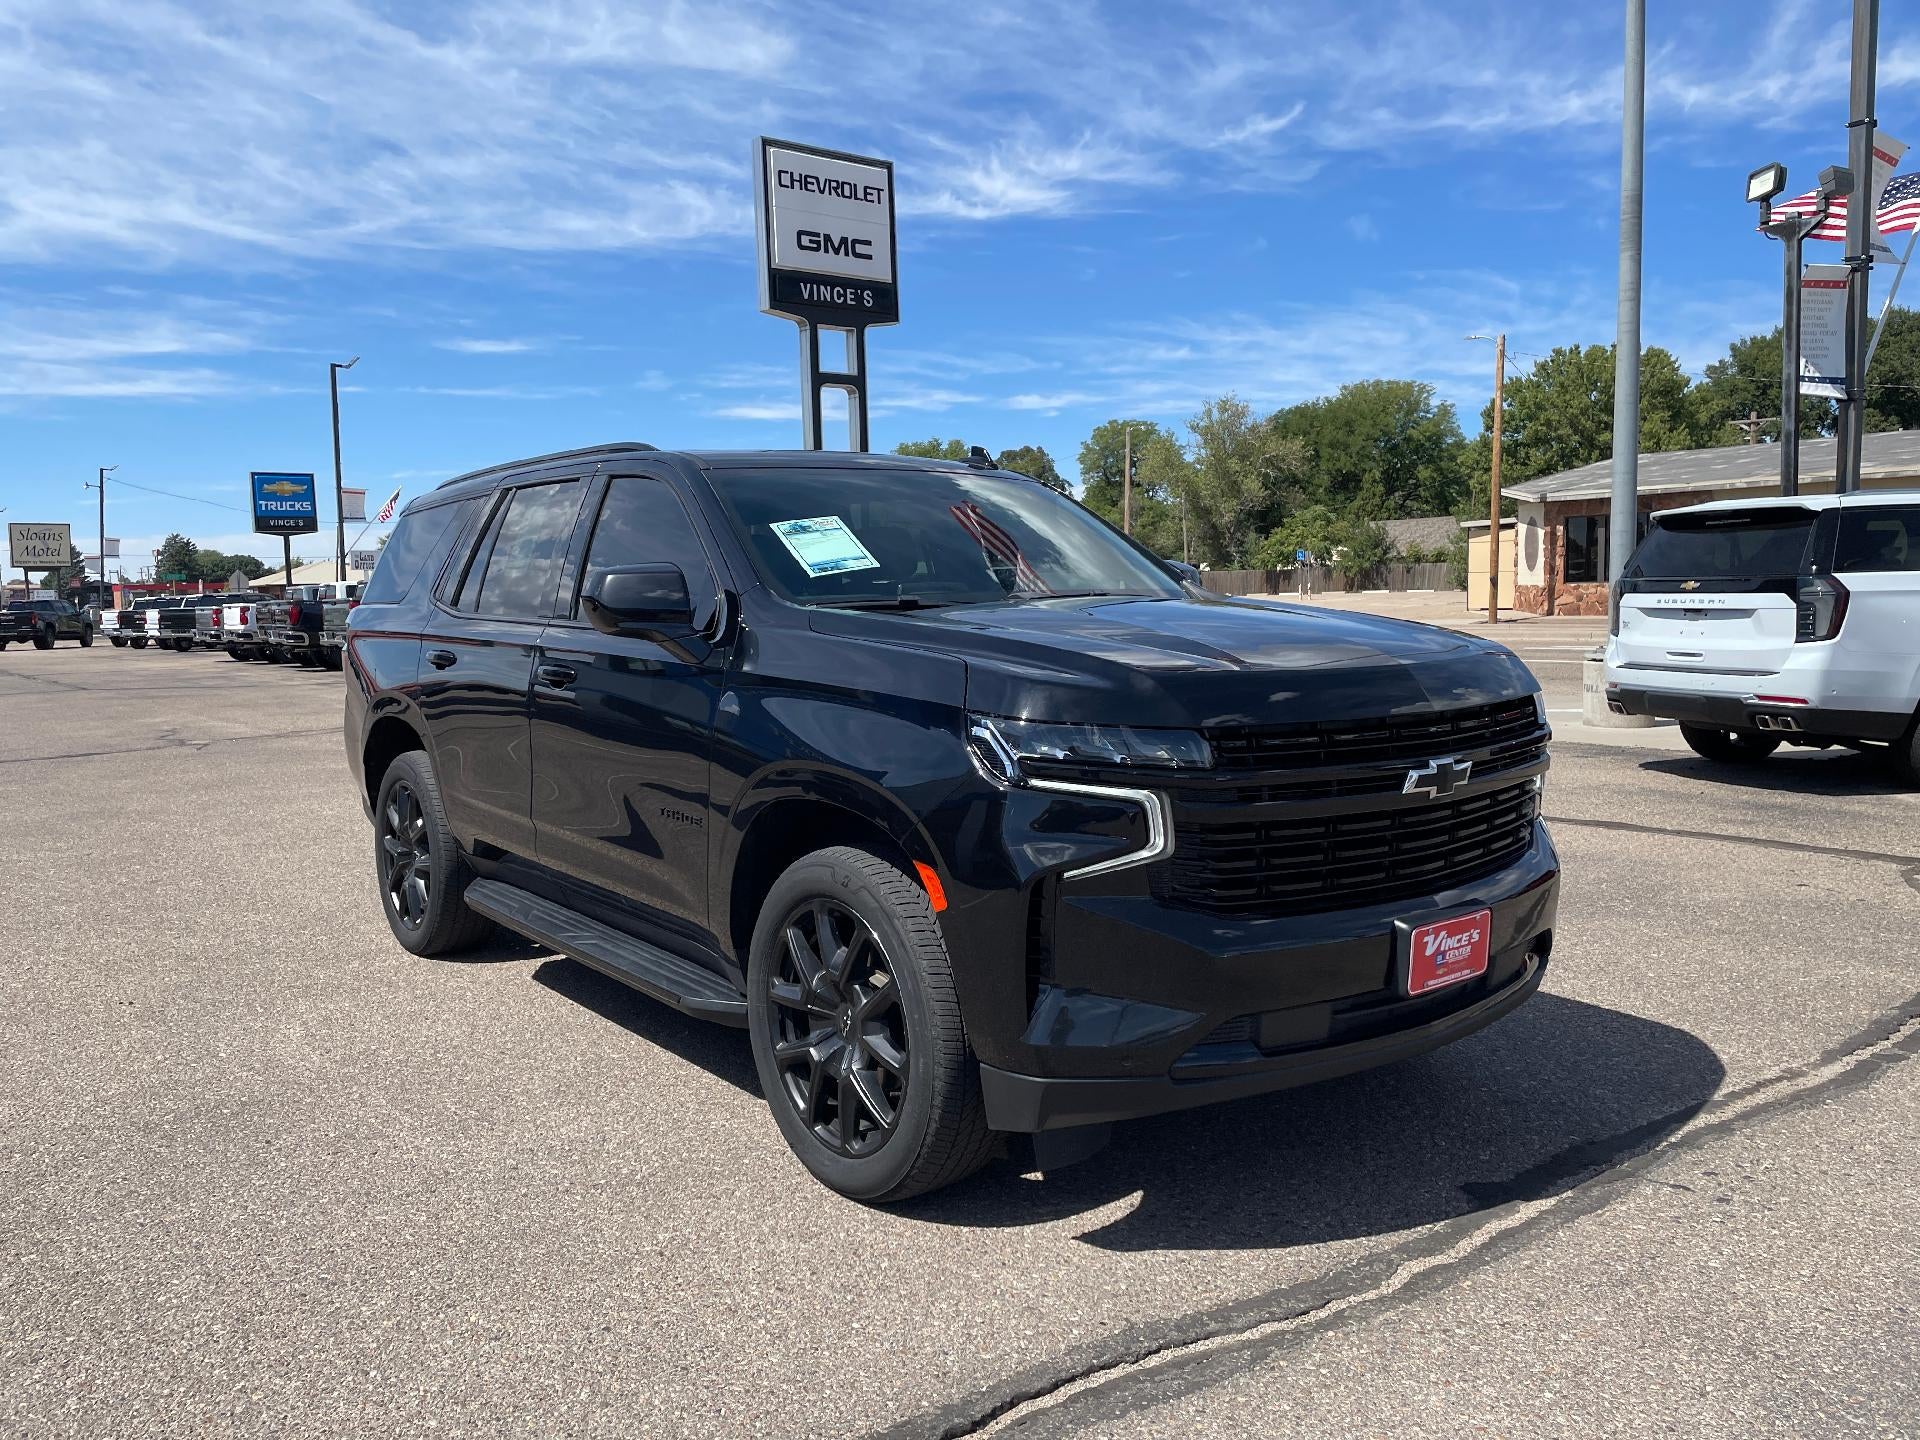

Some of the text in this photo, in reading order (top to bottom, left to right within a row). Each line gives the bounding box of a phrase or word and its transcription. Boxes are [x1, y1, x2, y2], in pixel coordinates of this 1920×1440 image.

[778, 169, 884, 205] CHEVROLET
[796, 229, 873, 260] GMC
[799, 282, 873, 307] VINCE'S
[259, 501, 311, 511] TRUCKS
[269, 519, 304, 527] VINCE'S
[17, 527, 64, 541] Sloans
[20, 543, 62, 557] Motel
[1423, 929, 1480, 956] VINCE'S
[1446, 945, 1472, 959] CENTER
